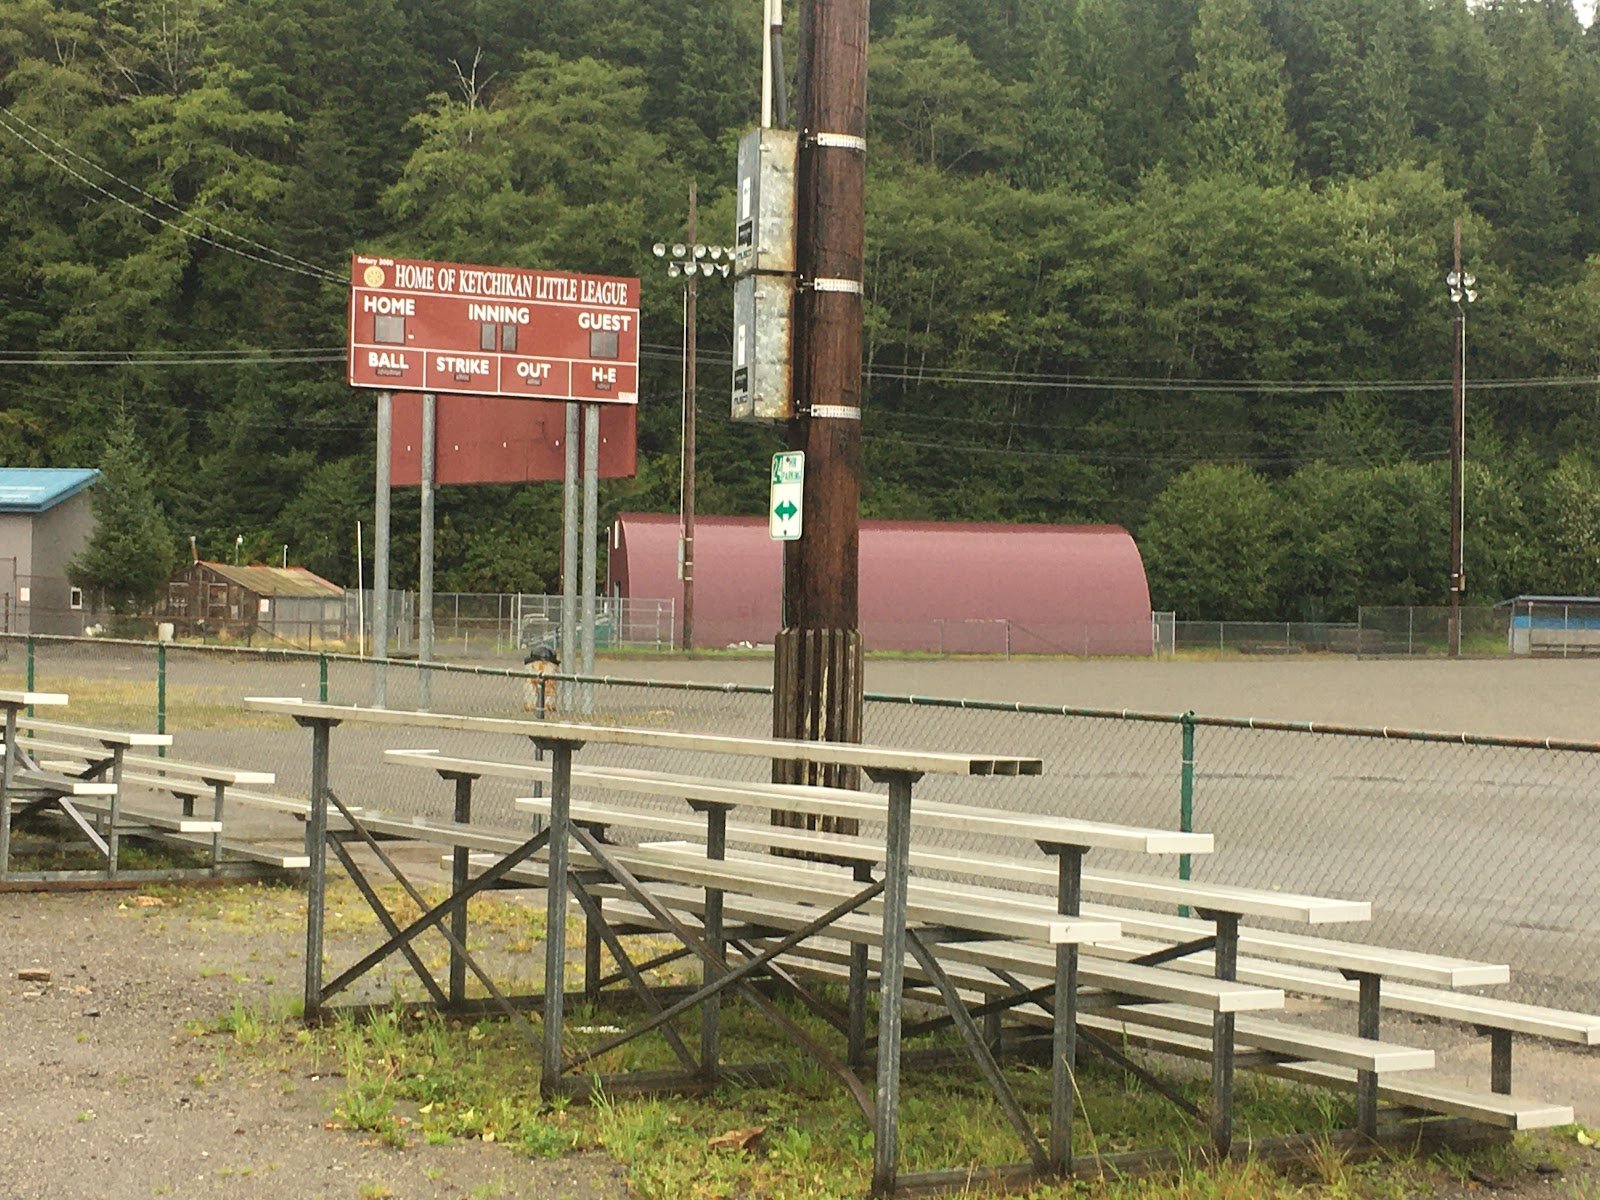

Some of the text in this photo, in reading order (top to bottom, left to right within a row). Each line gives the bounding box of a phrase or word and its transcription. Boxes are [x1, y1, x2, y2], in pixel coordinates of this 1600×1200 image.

[395, 264, 628, 306] HOME OF KETCHIKAN LITTLE LEAGUE
[363, 295, 415, 316] HOME
[468, 303, 530, 325] INNING
[578, 312, 632, 332] GUEST
[368, 351, 409, 369] BALL
[436, 356, 490, 375] STRIKE
[516, 361, 551, 379] OUT
